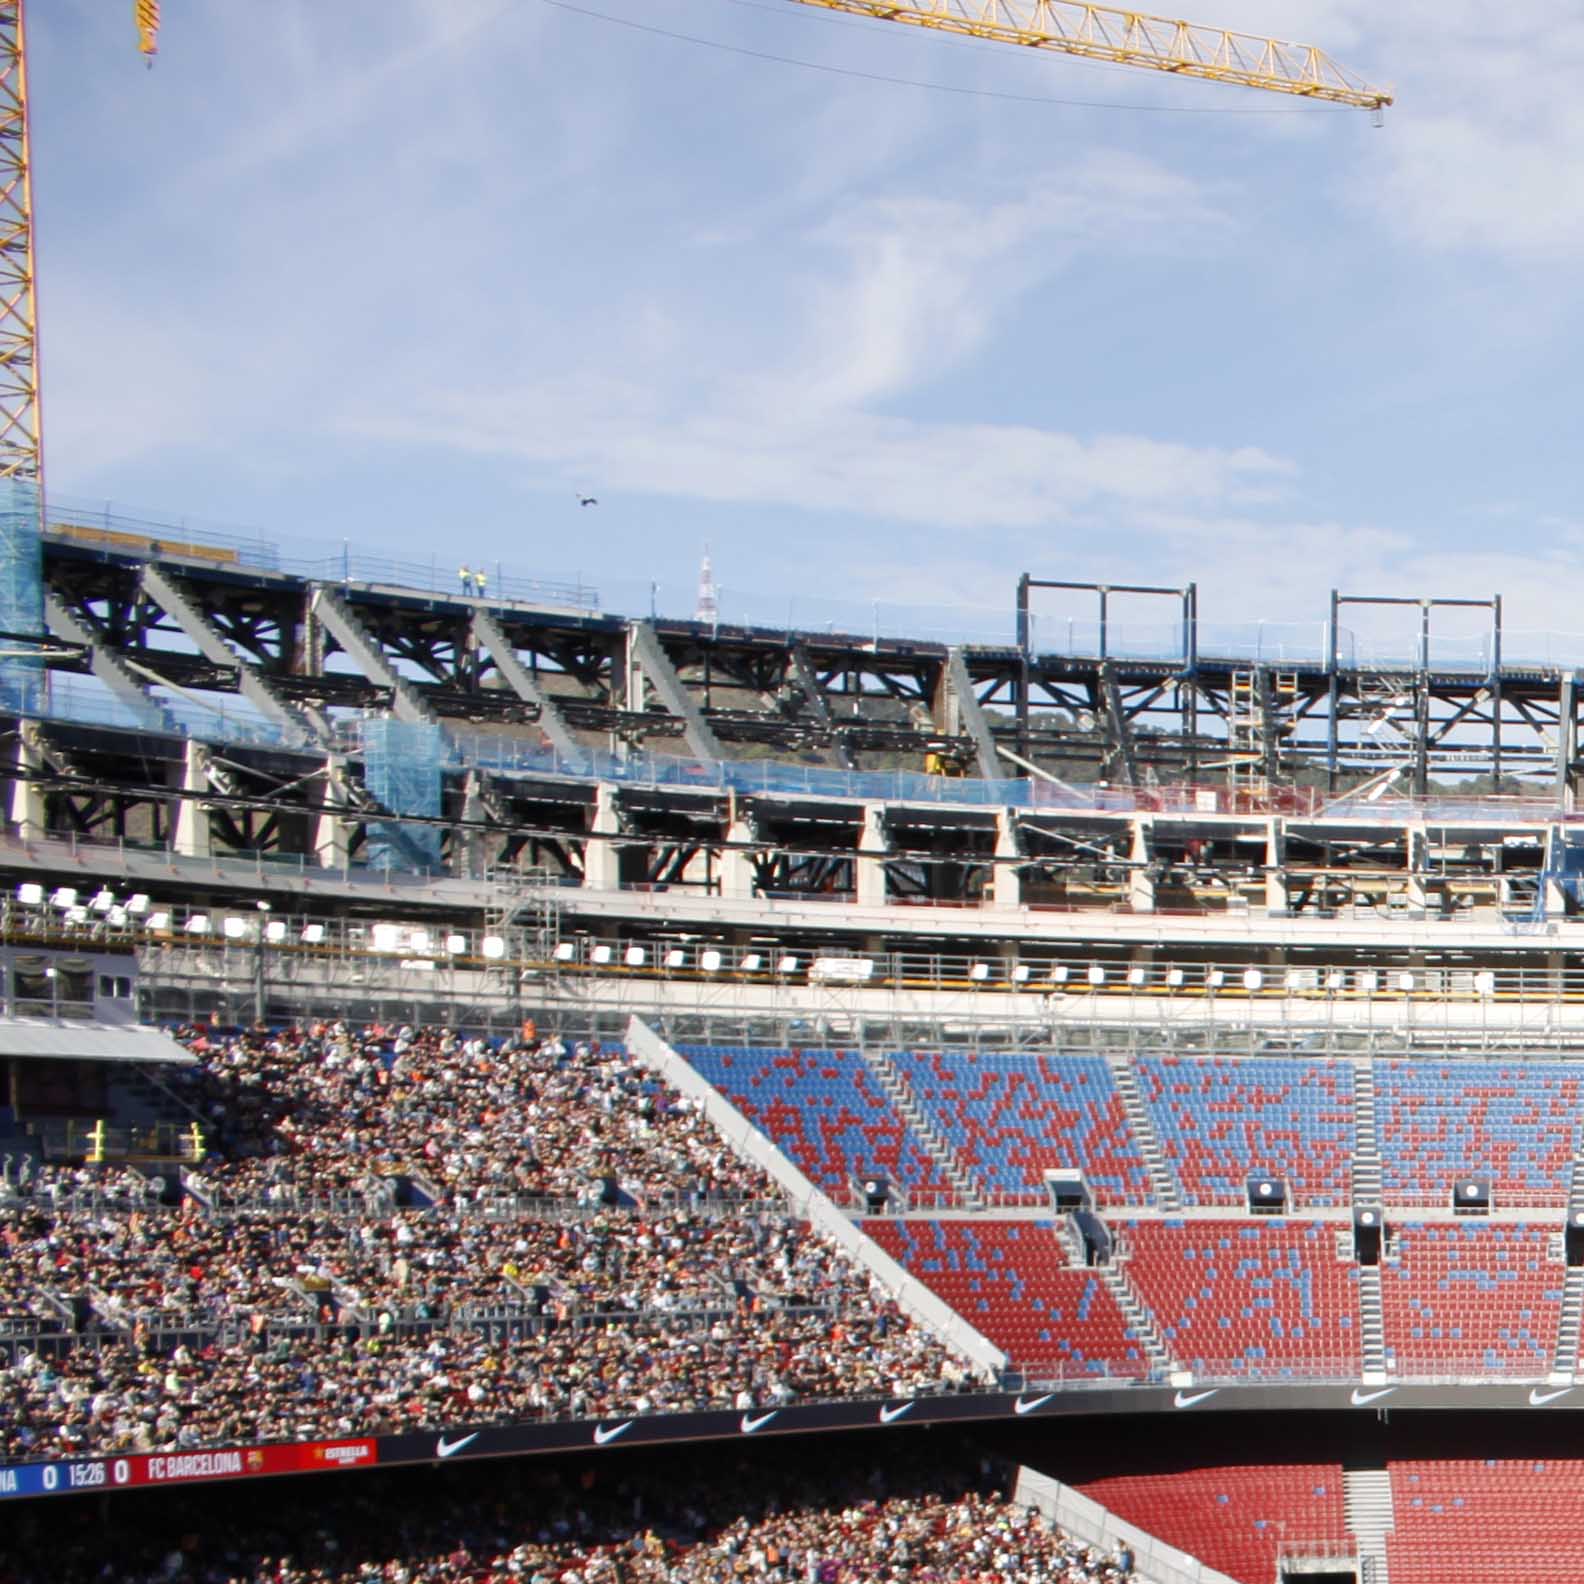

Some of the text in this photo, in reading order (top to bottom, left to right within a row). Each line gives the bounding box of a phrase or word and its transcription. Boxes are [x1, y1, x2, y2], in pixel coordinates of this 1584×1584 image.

[42, 1465, 57, 1490] 0
[69, 1462, 105, 1487] 15:26
[114, 1459, 129, 1484] 0
[148, 1456, 166, 1479] FC
[167, 1451, 242, 1478] BARCELONA
